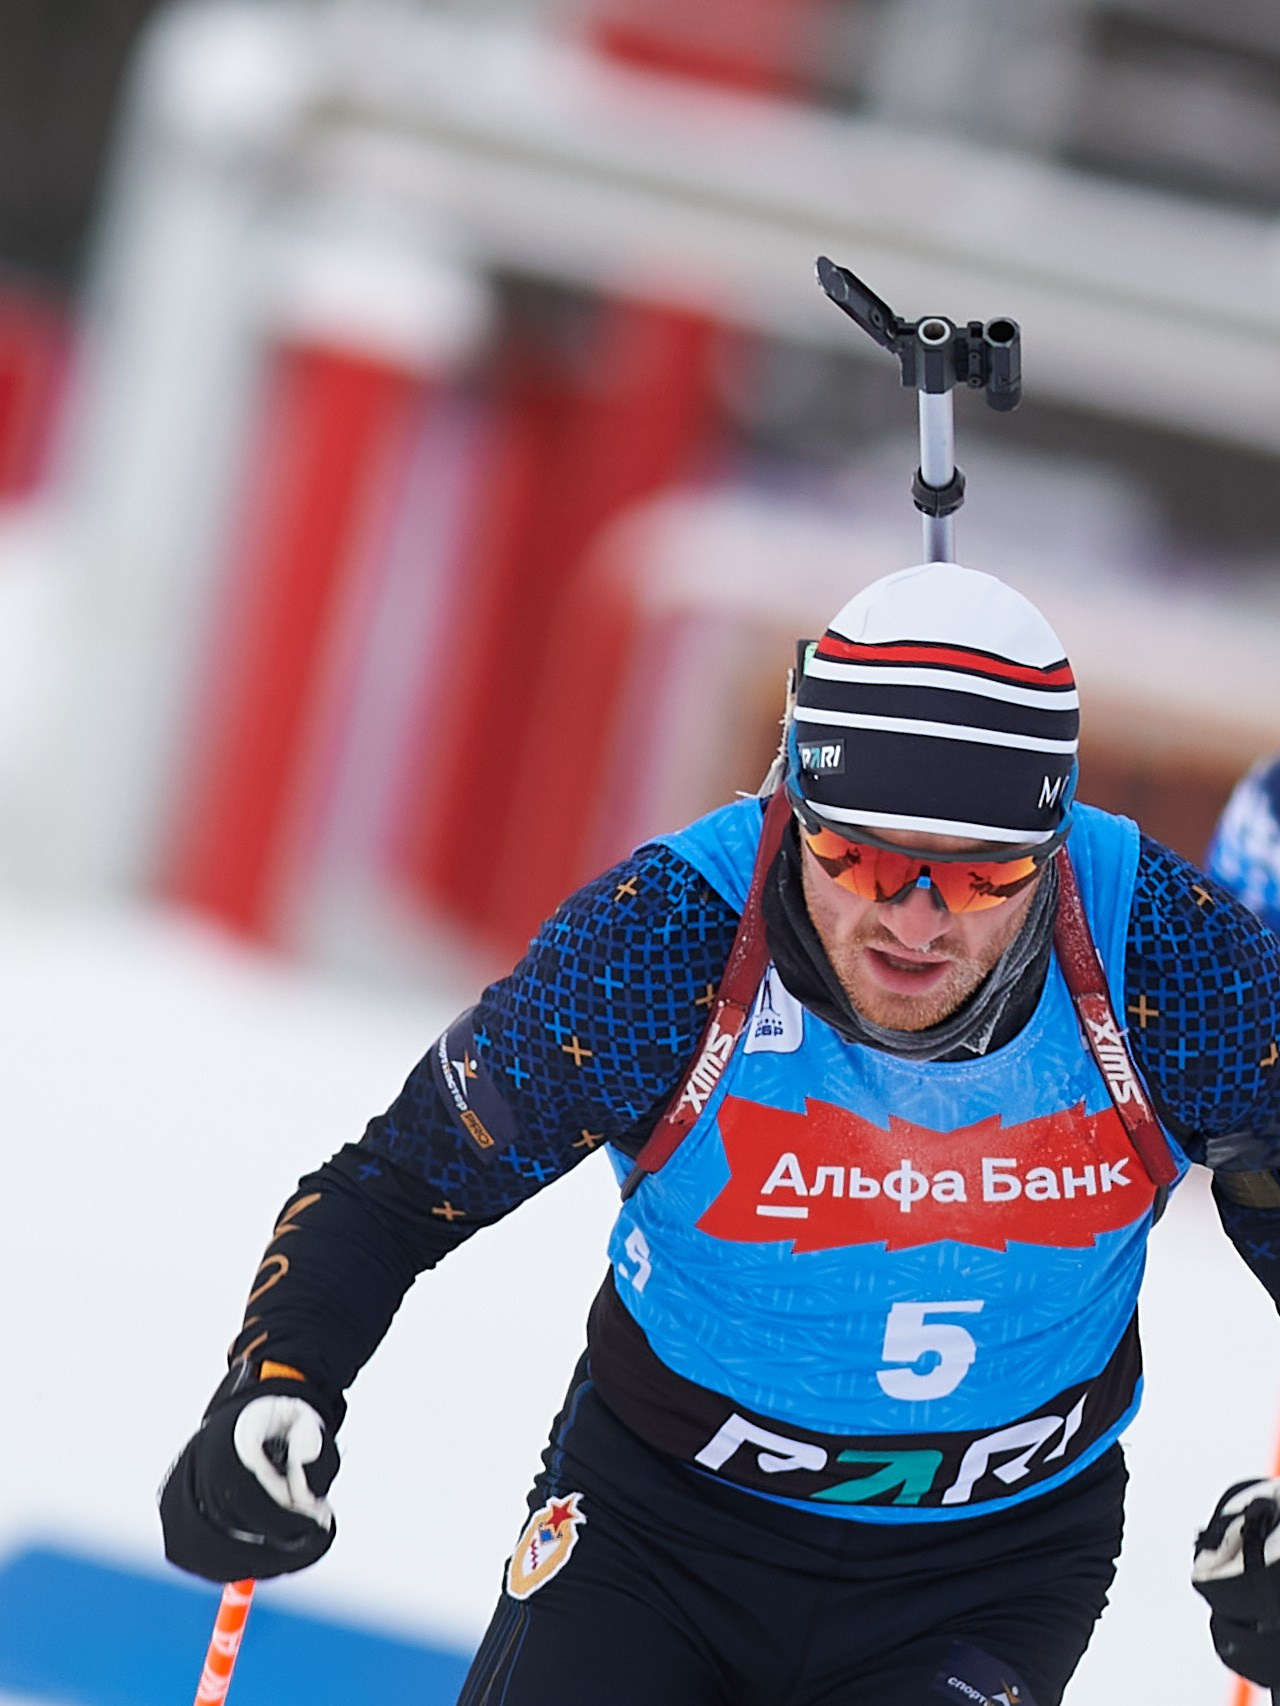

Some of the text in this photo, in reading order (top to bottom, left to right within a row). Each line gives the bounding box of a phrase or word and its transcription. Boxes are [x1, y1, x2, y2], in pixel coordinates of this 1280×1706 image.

[801, 744, 841, 769] PARI
[758, 1152, 1132, 1215] Альфа Банк
[875, 1299, 985, 1401] 5
[693, 1391, 1089, 1505] PARI
